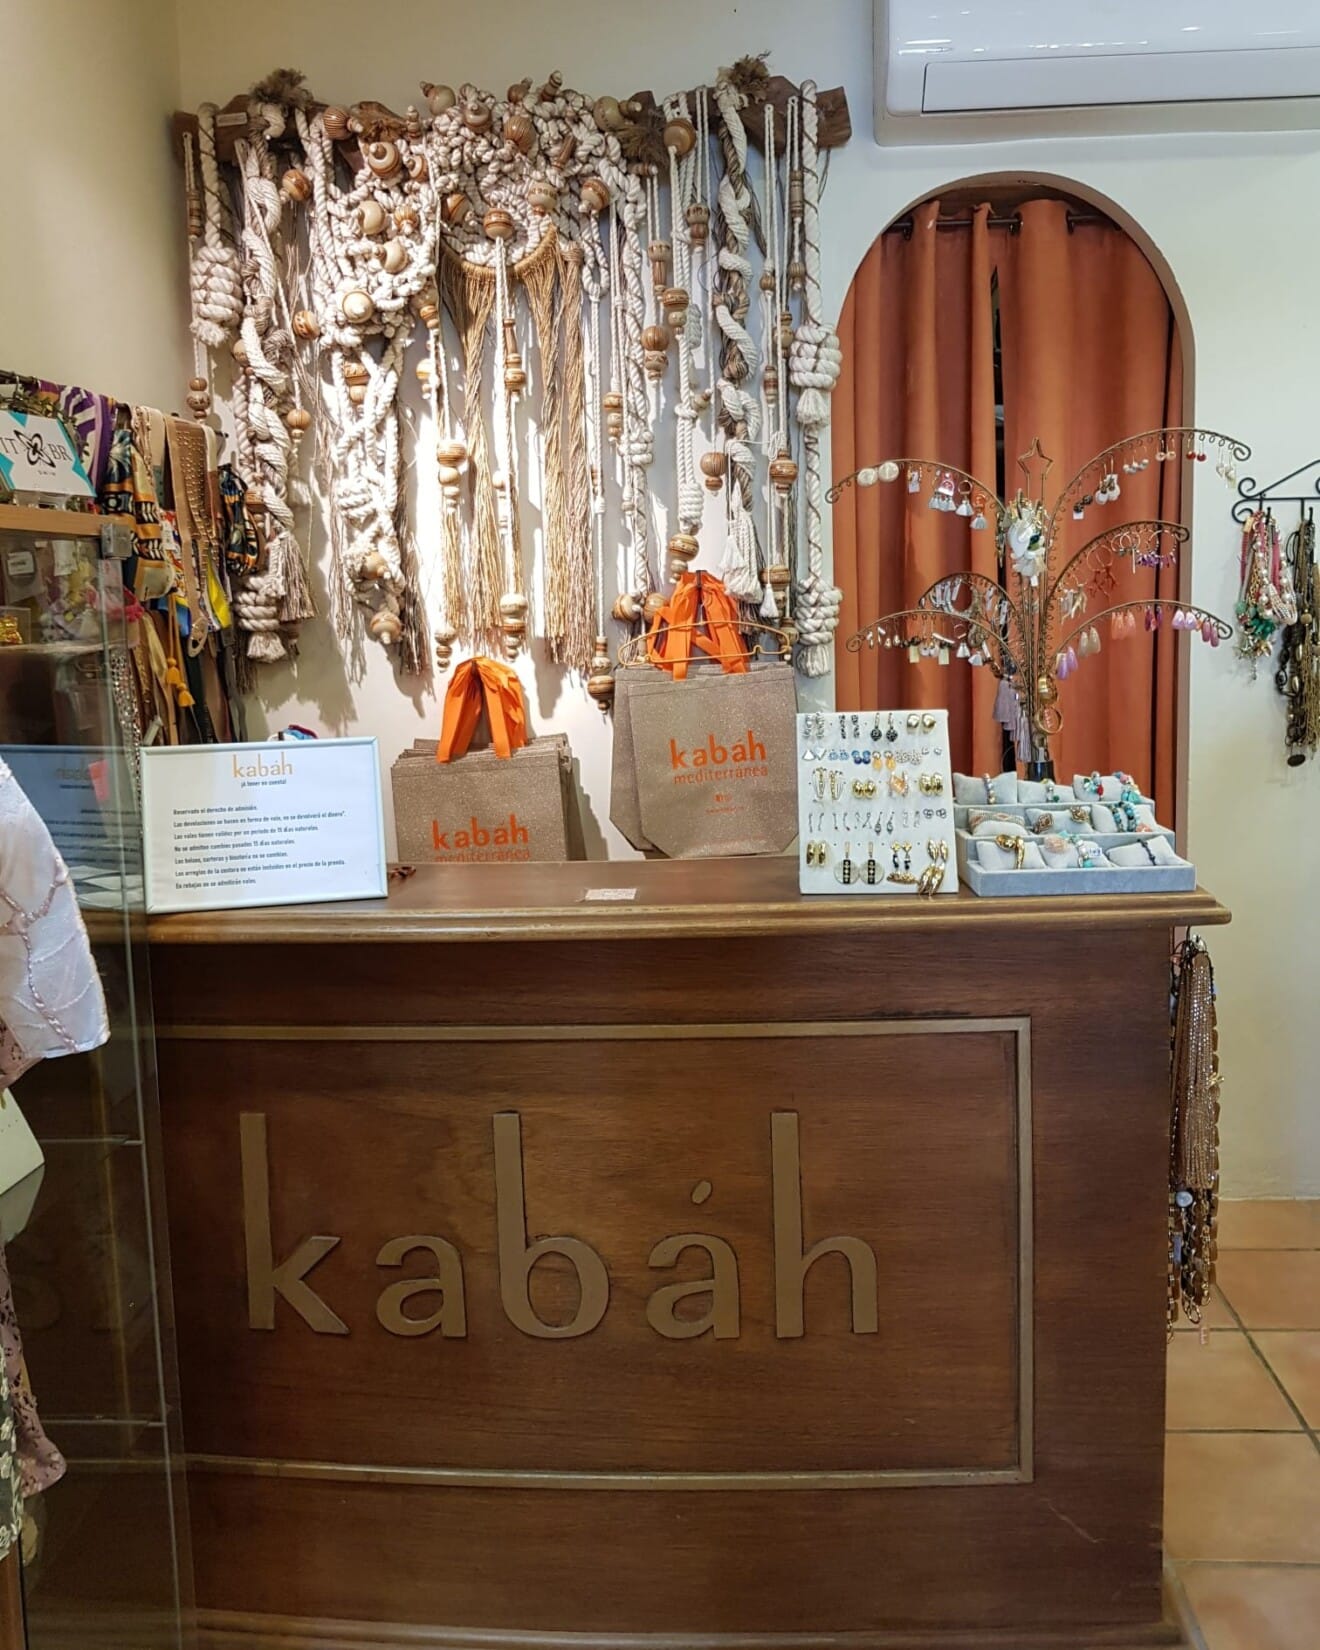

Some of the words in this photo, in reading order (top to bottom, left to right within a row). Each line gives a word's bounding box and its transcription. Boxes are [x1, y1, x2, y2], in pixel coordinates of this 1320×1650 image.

[670, 729, 766, 770] kabáh
[432, 812, 529, 850] kabáh
[240, 1110, 878, 1340] kabáh
